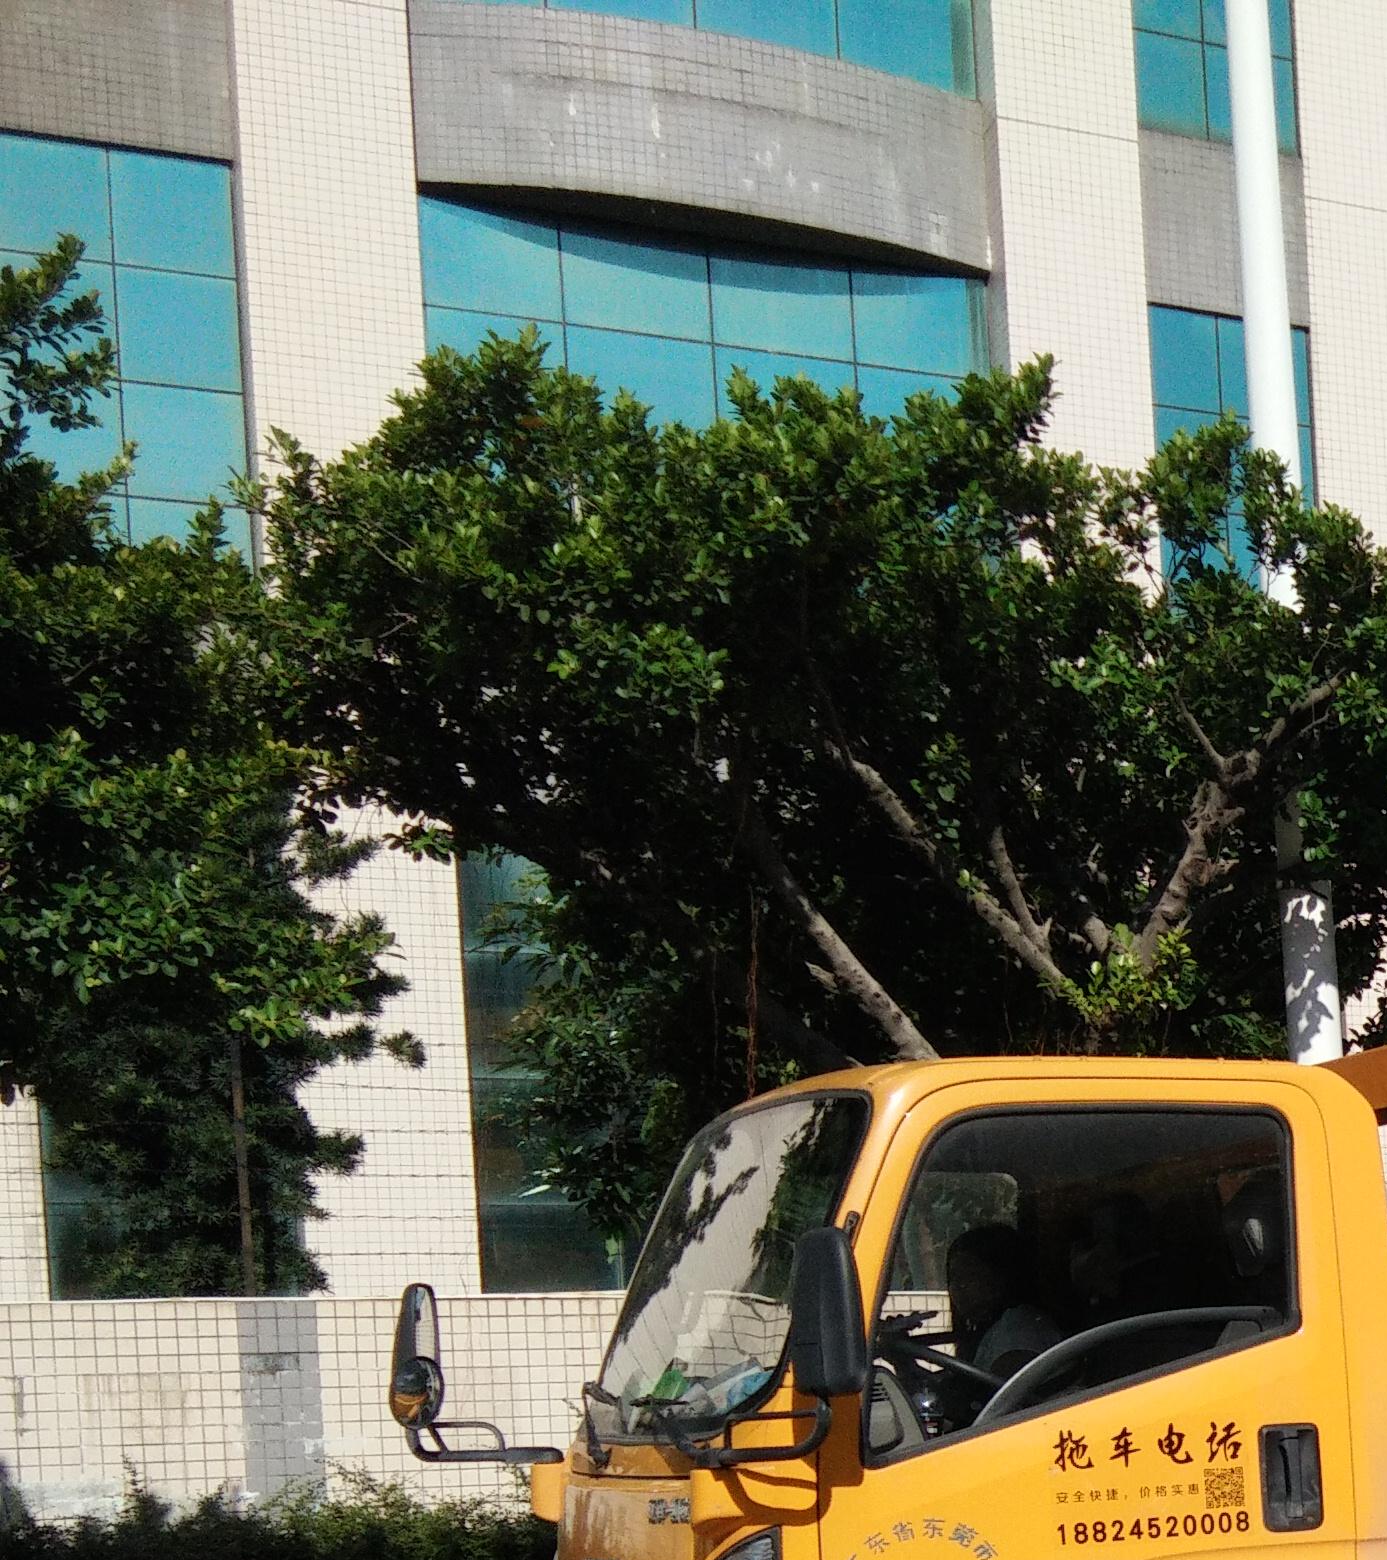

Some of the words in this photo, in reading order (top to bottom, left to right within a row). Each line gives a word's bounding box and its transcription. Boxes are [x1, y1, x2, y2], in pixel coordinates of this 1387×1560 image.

[1053, 1421, 1242, 1472] 拖车电话
[1057, 1511, 1250, 1545] 18824520008
